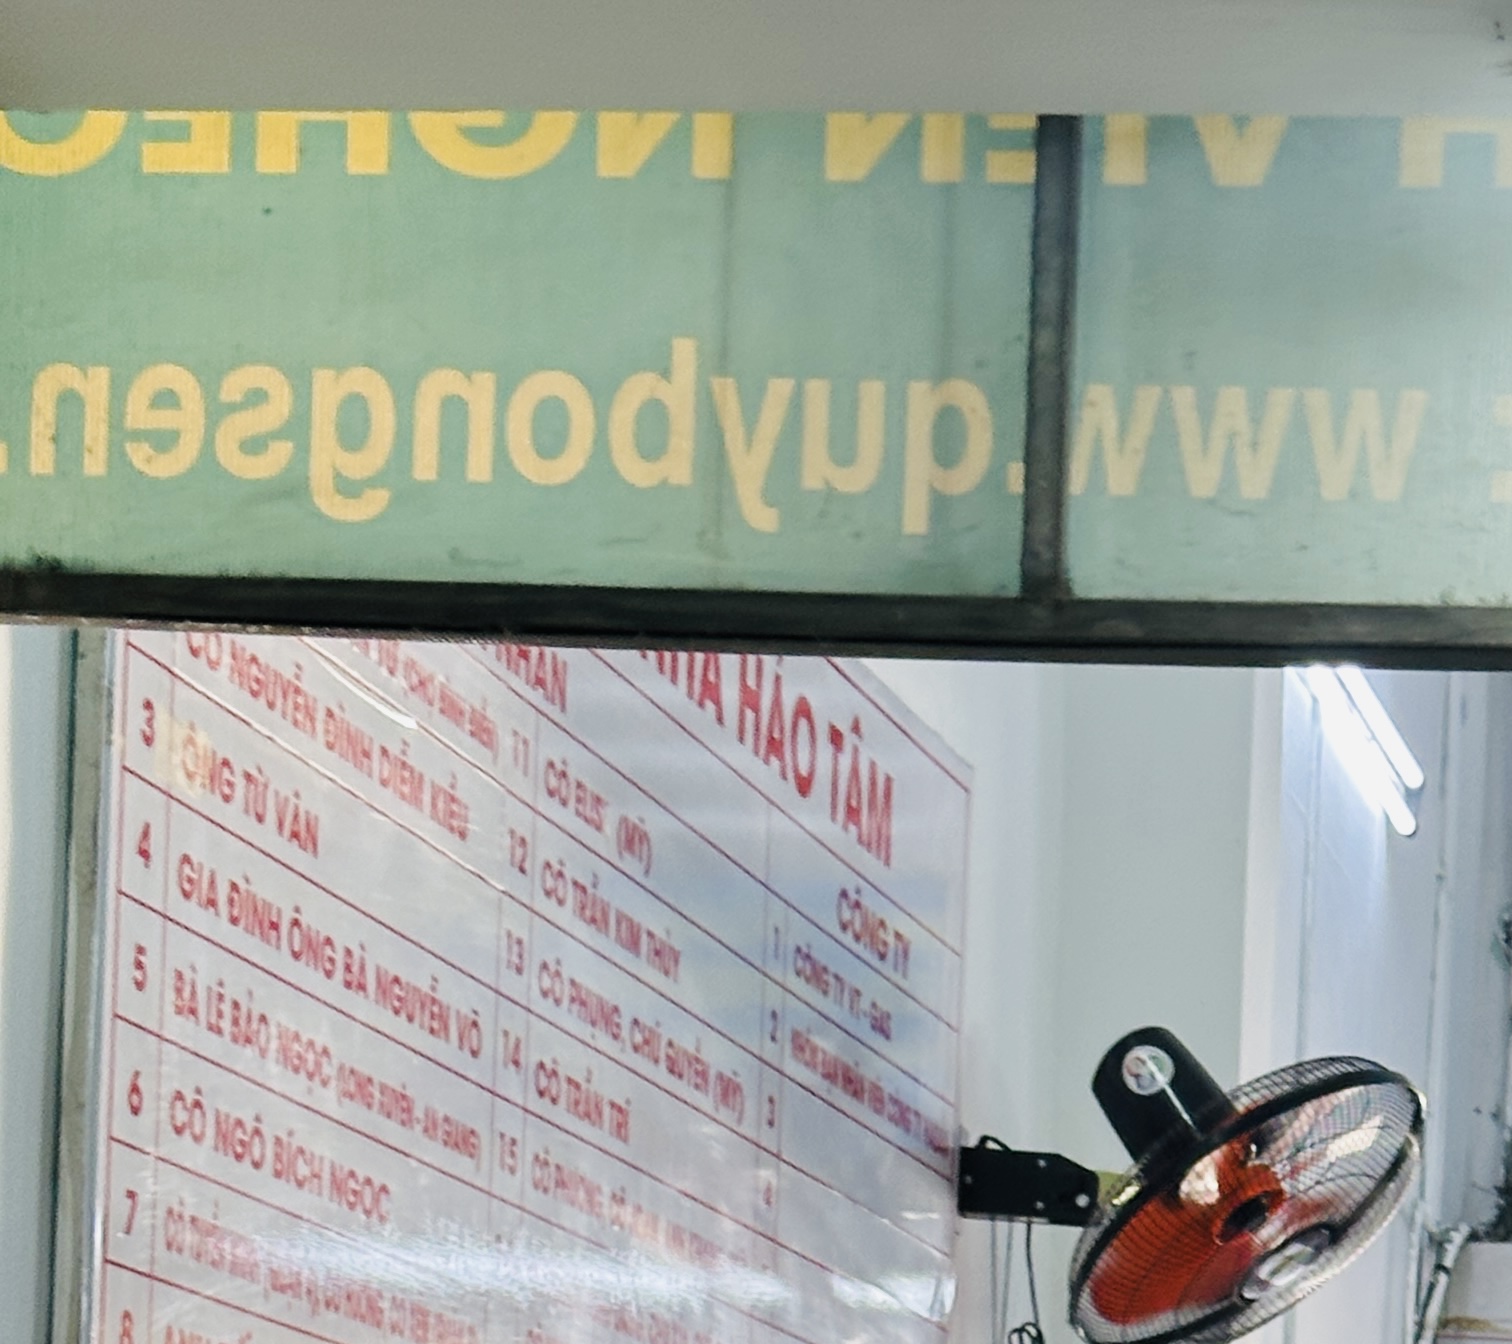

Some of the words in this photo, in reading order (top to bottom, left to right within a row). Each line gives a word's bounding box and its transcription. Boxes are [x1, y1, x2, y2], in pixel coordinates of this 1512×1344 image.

[142, 699, 155, 748] 3
[544, 756, 571, 808] CÔ
[828, 714, 894, 868] TÂM
[136, 822, 151, 868] 4
[177, 853, 219, 916] GIA
[227, 875, 282, 951] ĐÌNH
[287, 906, 337, 980] ÔNG
[509, 827, 527, 875] 12
[541, 859, 568, 908] CÔ
[836, 884, 889, 962] CÔNG
[133, 943, 148, 991] 5
[506, 928, 524, 976] 13
[538, 957, 565, 1008] CÔ
[503, 1028, 521, 1074] 14
[534, 1058, 562, 1106] CÔ
[128, 1070, 143, 1117] 6
[170, 1087, 207, 1144] CÔ
[214, 1106, 266, 1170] NGÔ
[273, 1128, 322, 1197] BÍCH
[500, 1131, 518, 1176] 15
[124, 1189, 138, 1236] 7
